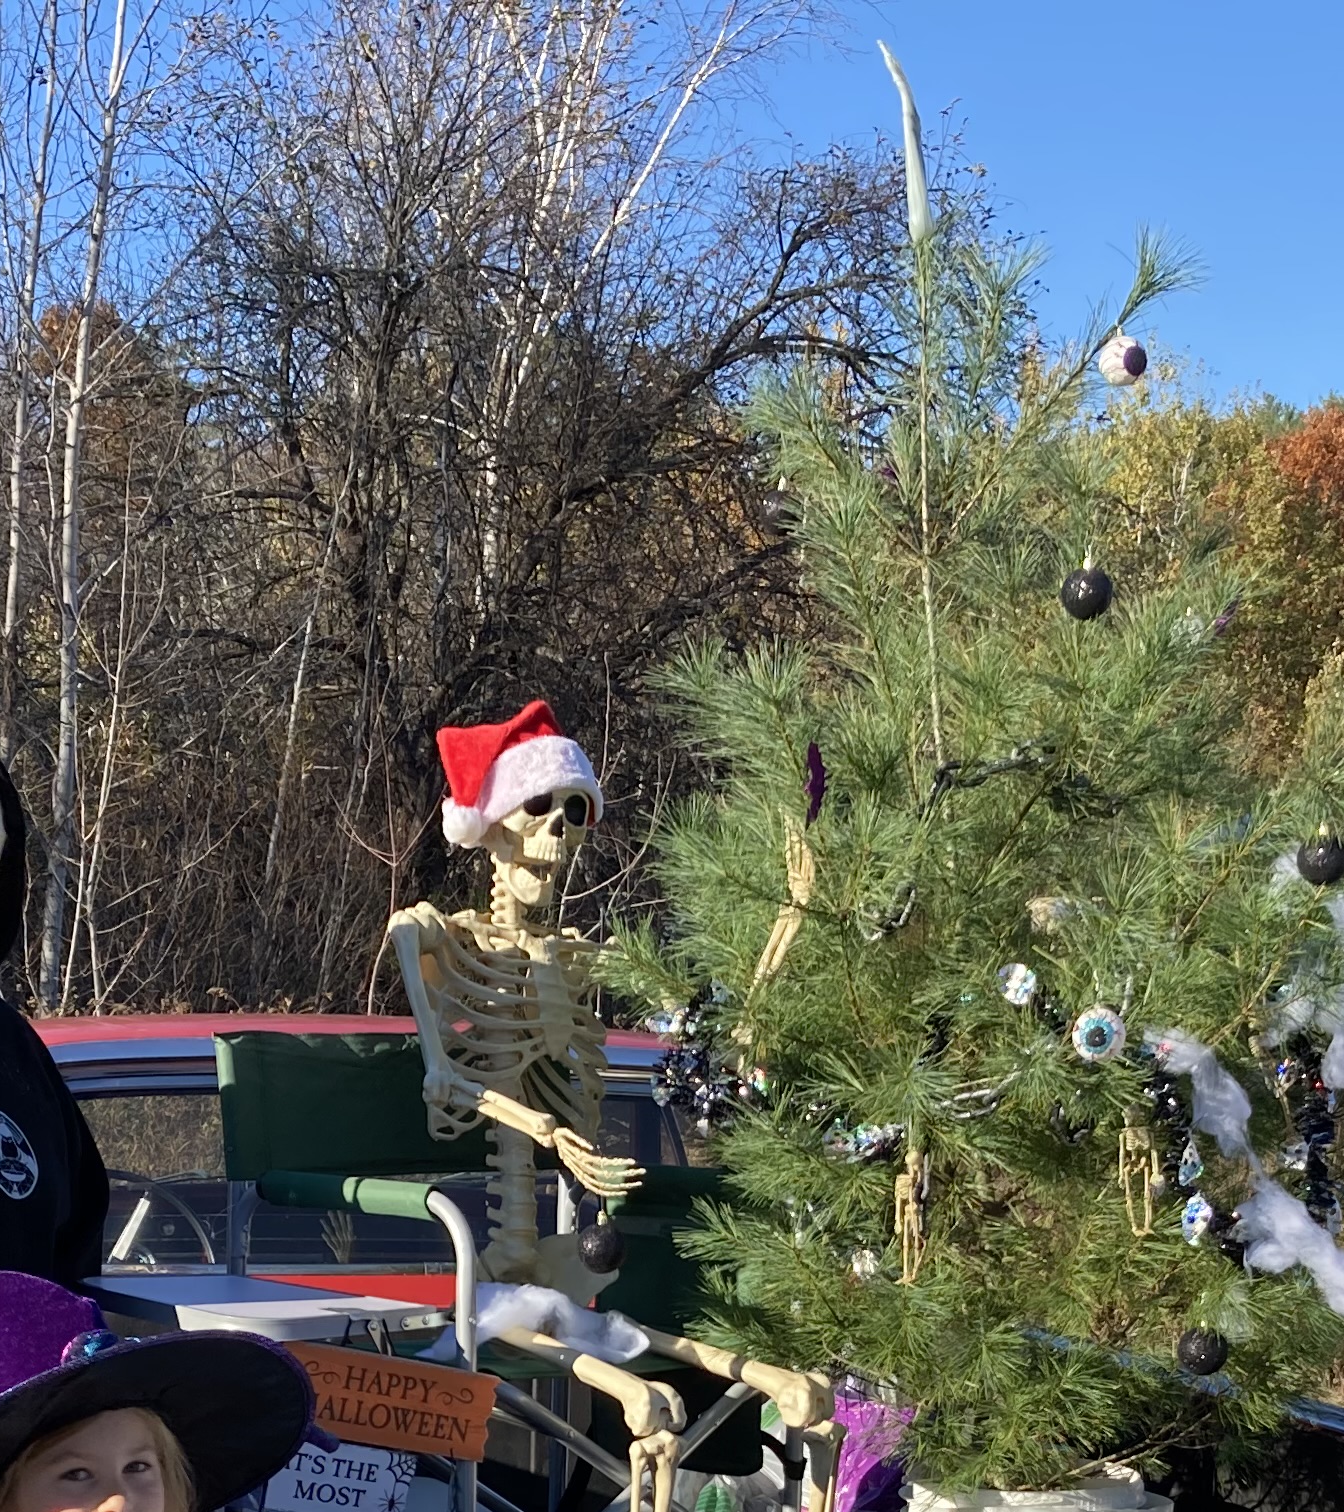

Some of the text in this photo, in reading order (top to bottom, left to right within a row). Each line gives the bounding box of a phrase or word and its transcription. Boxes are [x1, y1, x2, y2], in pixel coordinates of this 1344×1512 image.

[342, 1365, 438, 1404] HAPPY
[314, 1393, 471, 1443] ALLOWEEN
[331, 1457, 380, 1483] THE
[292, 1479, 367, 1508] MOST
